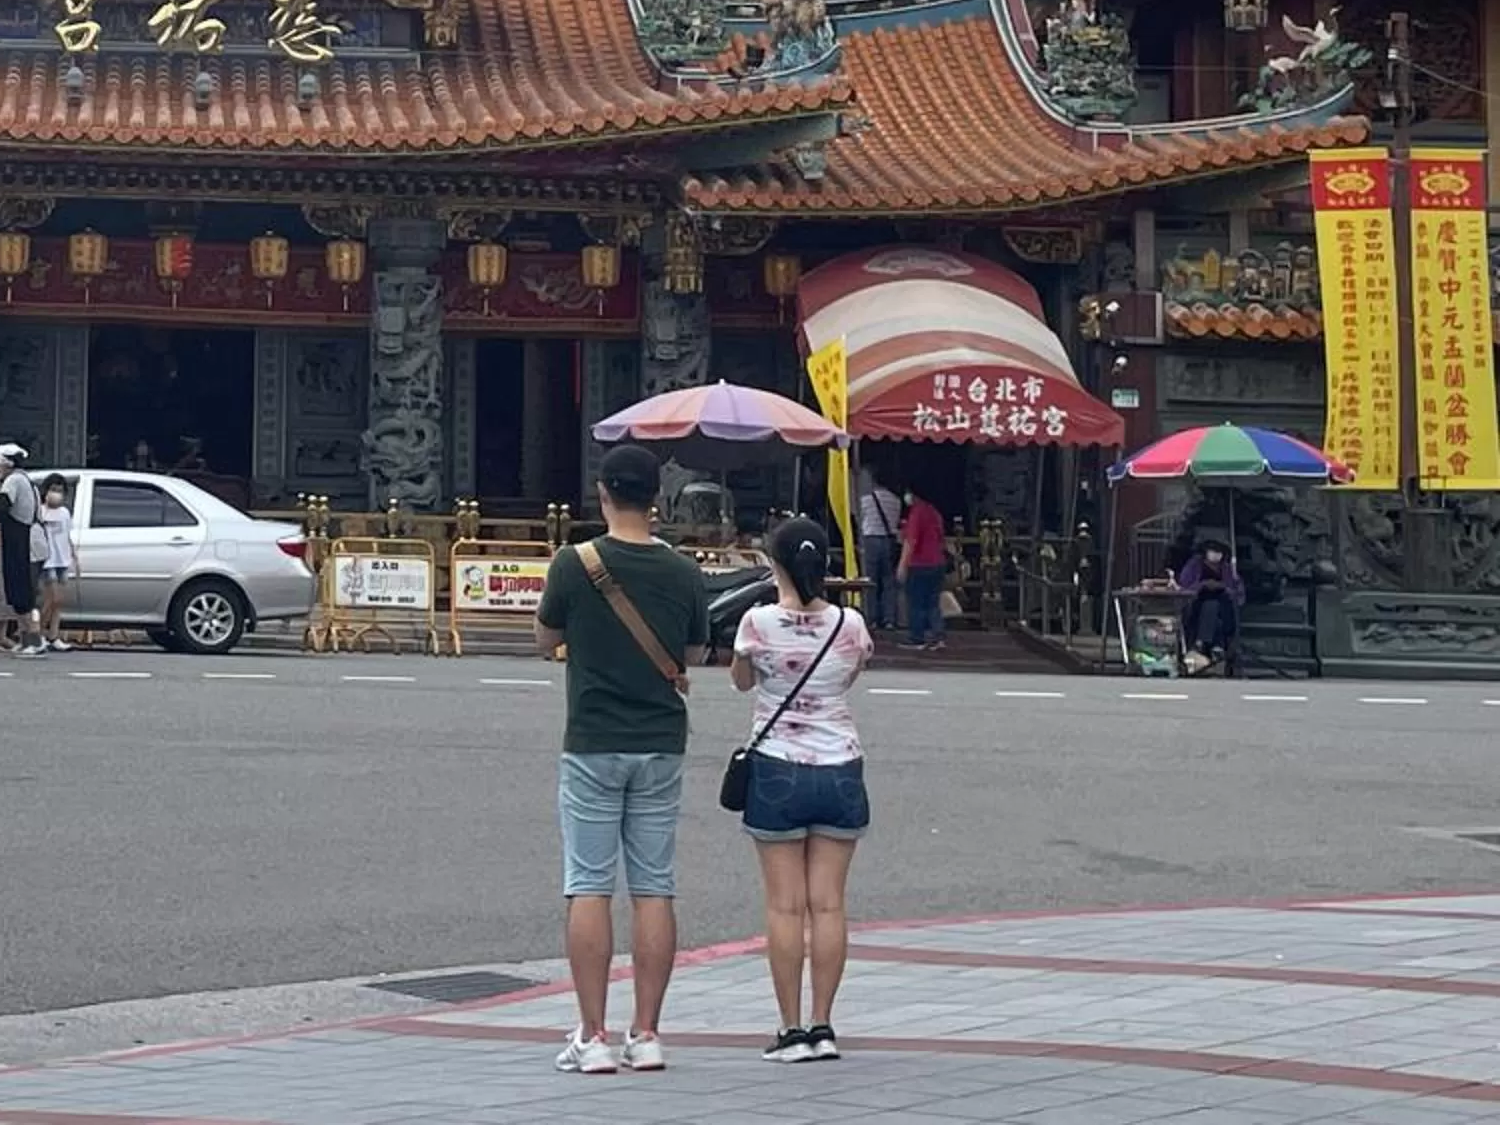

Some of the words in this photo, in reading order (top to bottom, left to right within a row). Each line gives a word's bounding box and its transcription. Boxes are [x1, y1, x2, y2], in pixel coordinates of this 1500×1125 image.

[968, 375, 1045, 405] 台北市
[913, 403, 1068, 437] 松山慈祐宮
